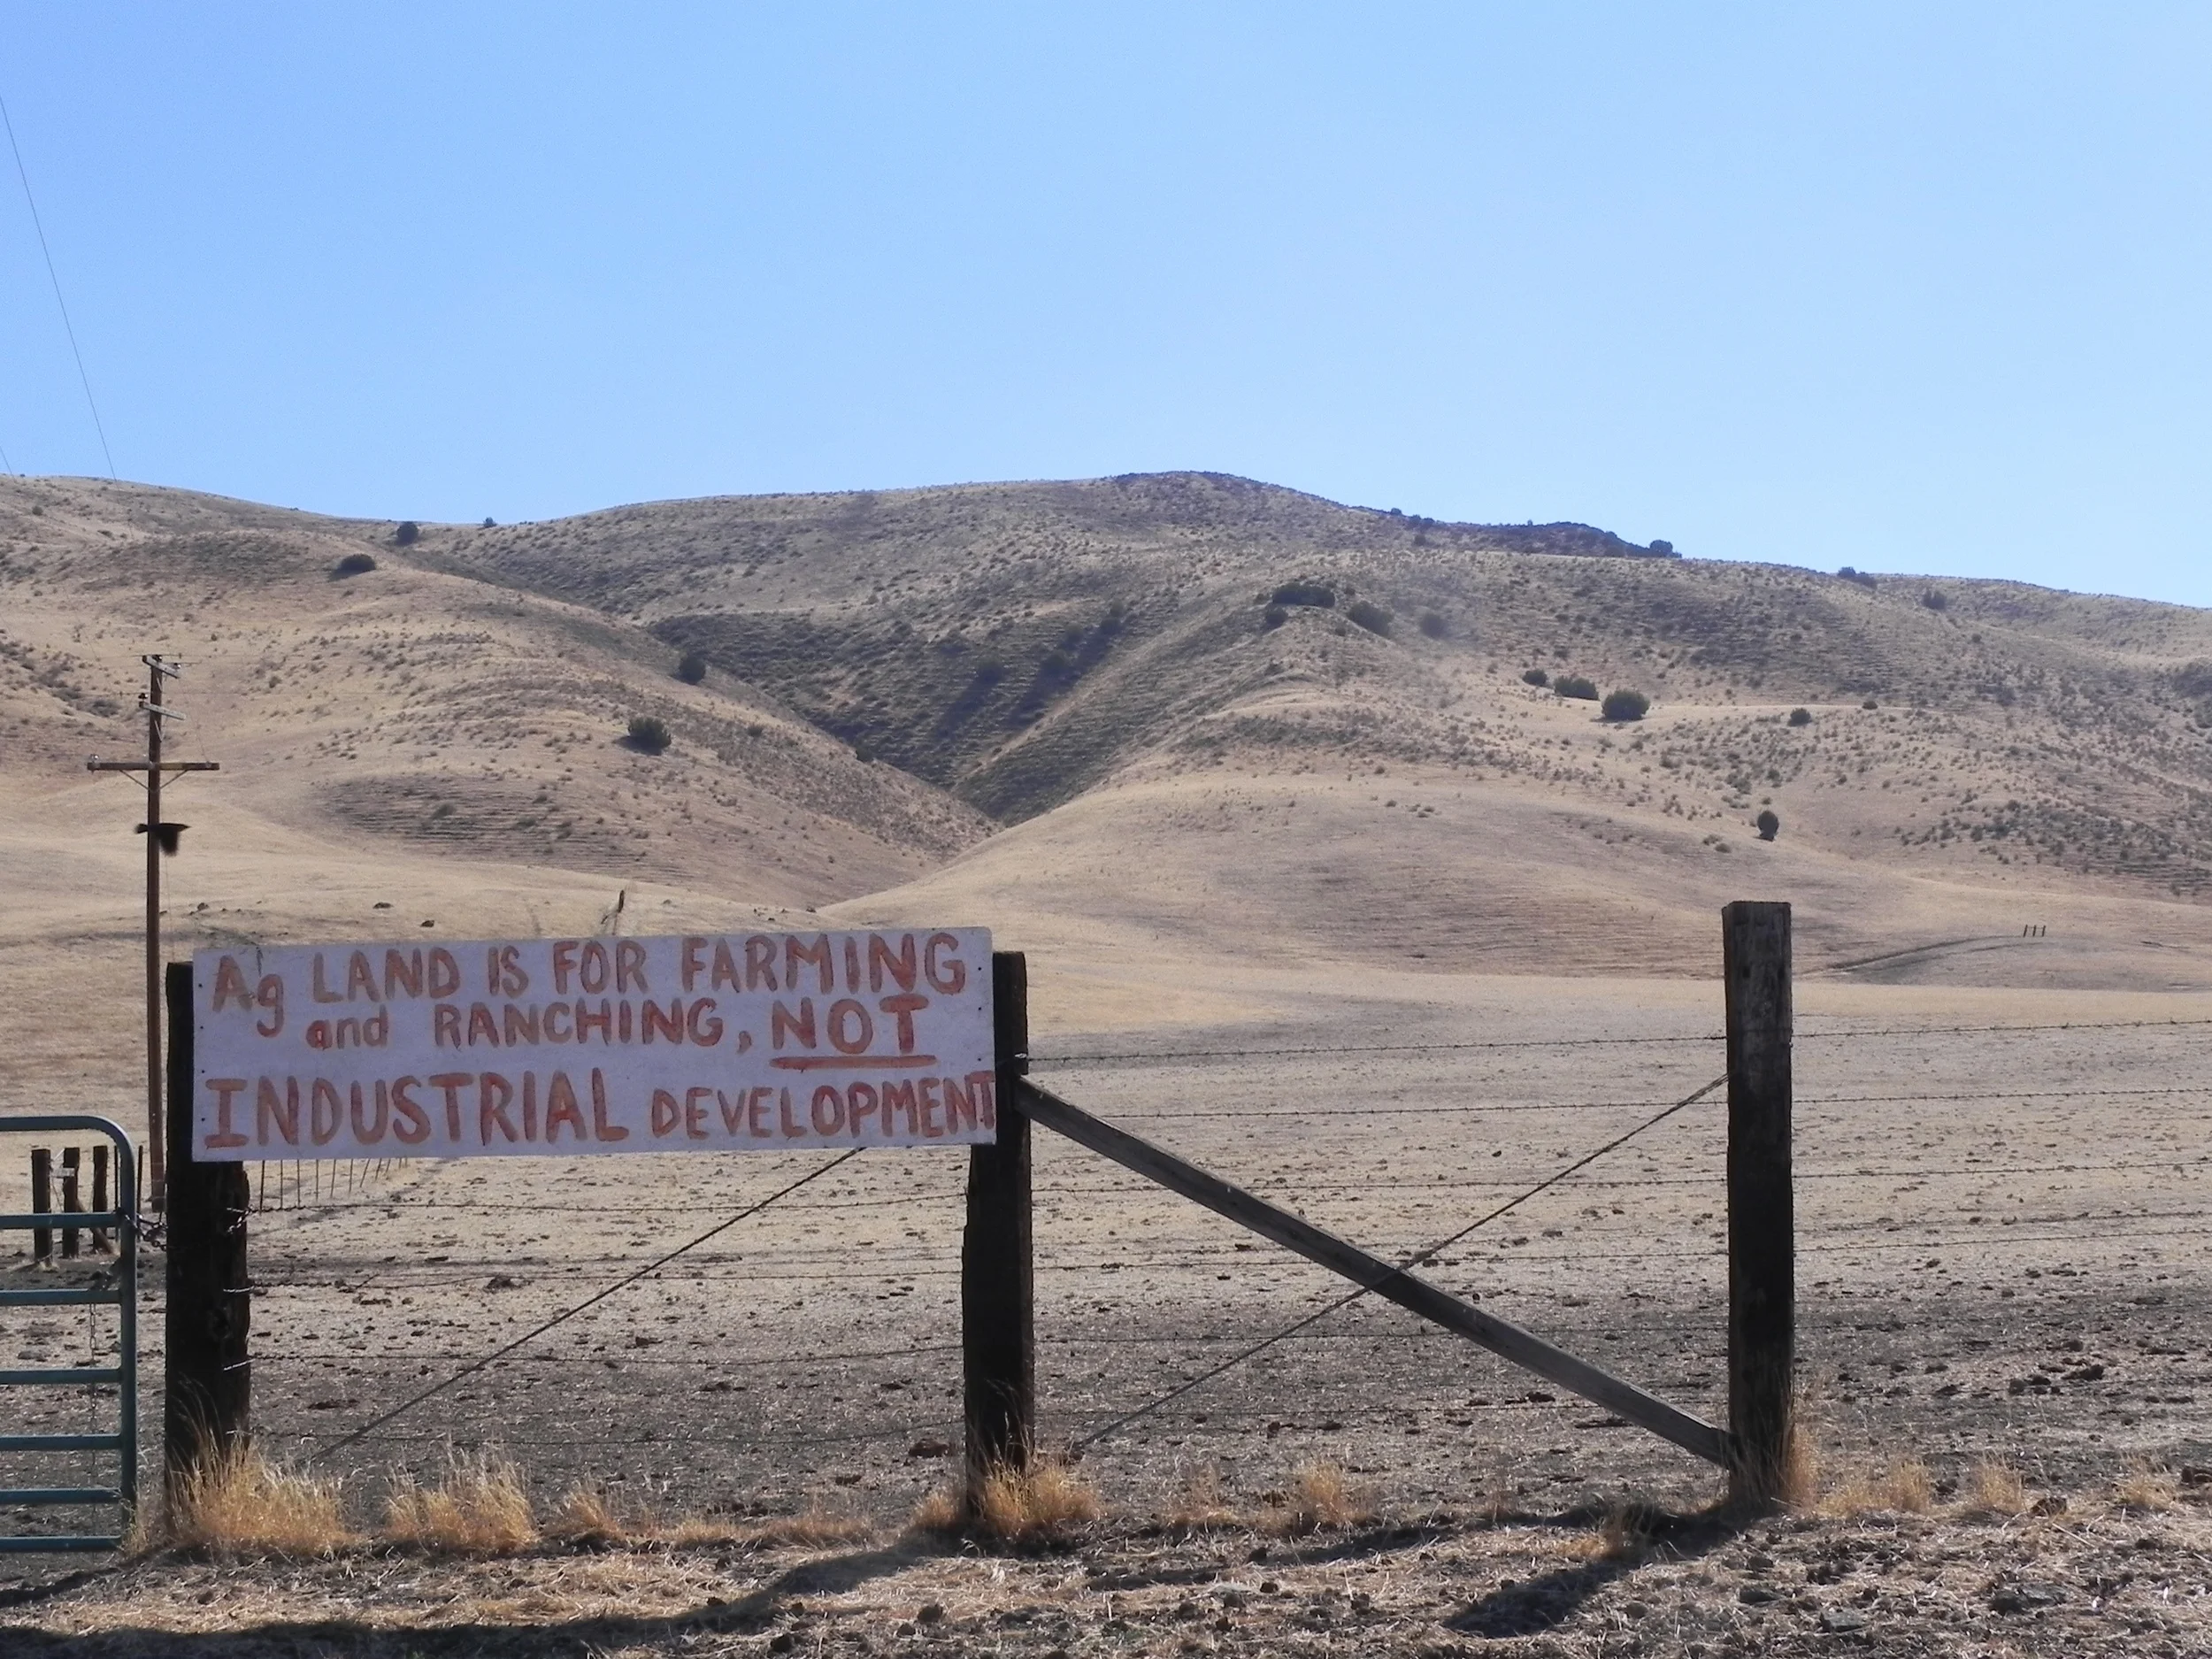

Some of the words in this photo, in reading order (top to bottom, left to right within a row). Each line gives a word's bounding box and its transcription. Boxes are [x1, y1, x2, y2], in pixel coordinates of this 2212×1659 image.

[212, 954, 284, 1038] Ag
[313, 946, 461, 1003] LAND
[488, 945, 530, 999] IS
[552, 940, 649, 995] FOR
[681, 932, 966, 995] FARMING
[305, 1005, 388, 1049] and
[434, 996, 752, 1055] RANCHING,
[772, 994, 929, 1056] NOT
[204, 1067, 629, 1149] INDUSTRIAL
[651, 1070, 995, 1140] DEVELOPMENT
